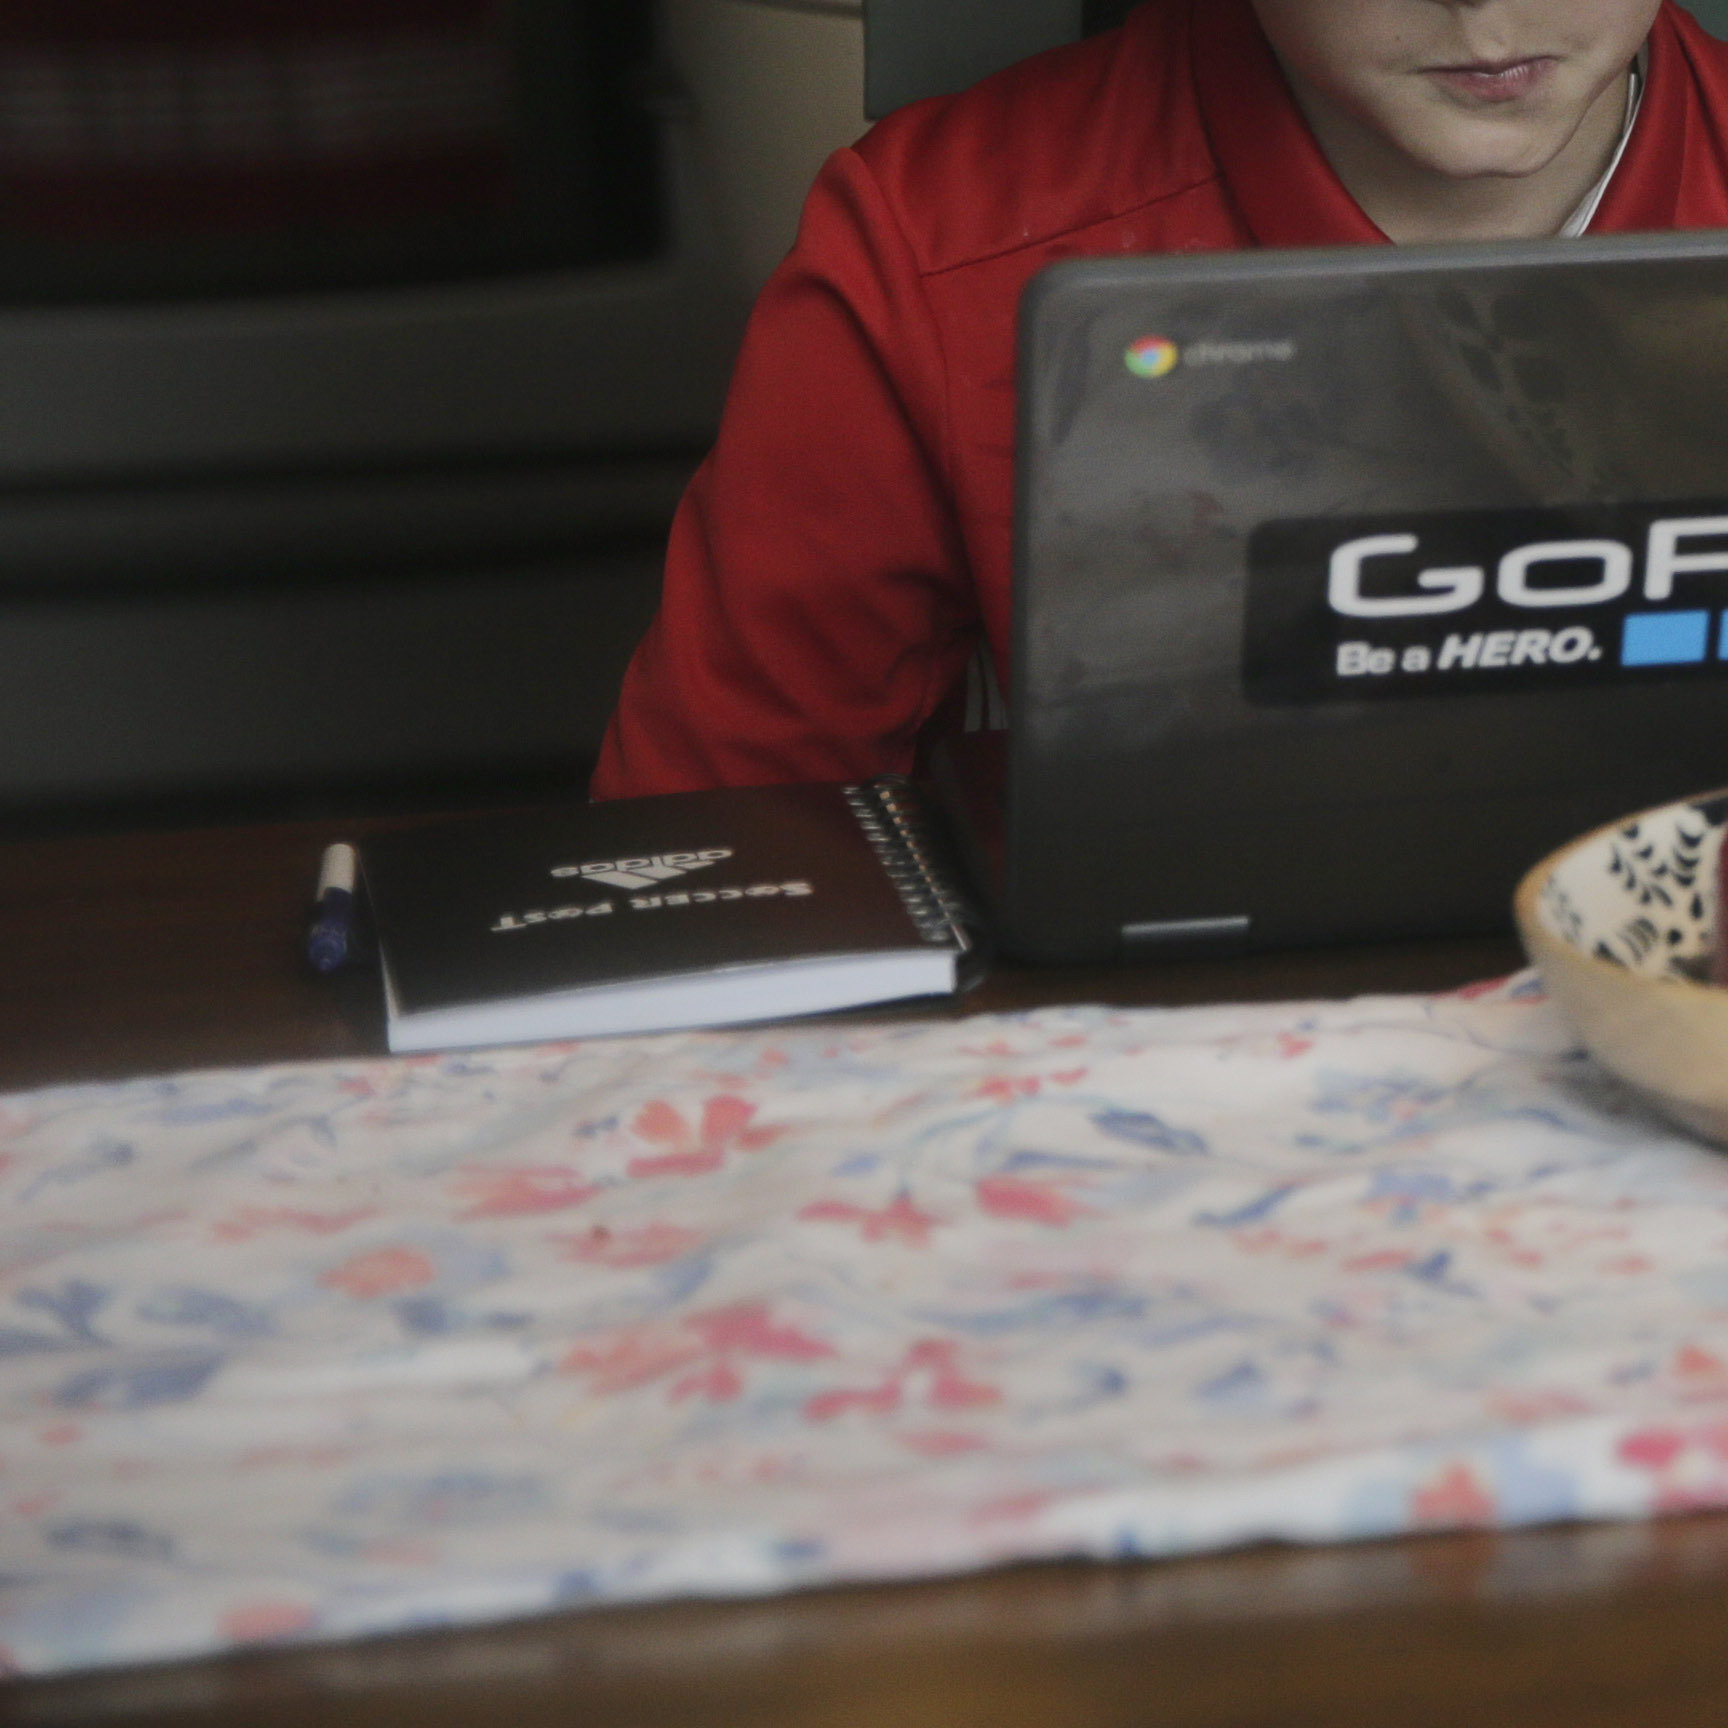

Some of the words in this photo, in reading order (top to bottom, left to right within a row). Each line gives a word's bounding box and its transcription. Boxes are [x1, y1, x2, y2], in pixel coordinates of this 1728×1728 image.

[1336, 640, 1396, 676] Be
[1401, 645, 1432, 672] a
[1436, 625, 1603, 670] HERO.
[550, 848, 734, 878] adidas
[490, 901, 614, 932] POST
